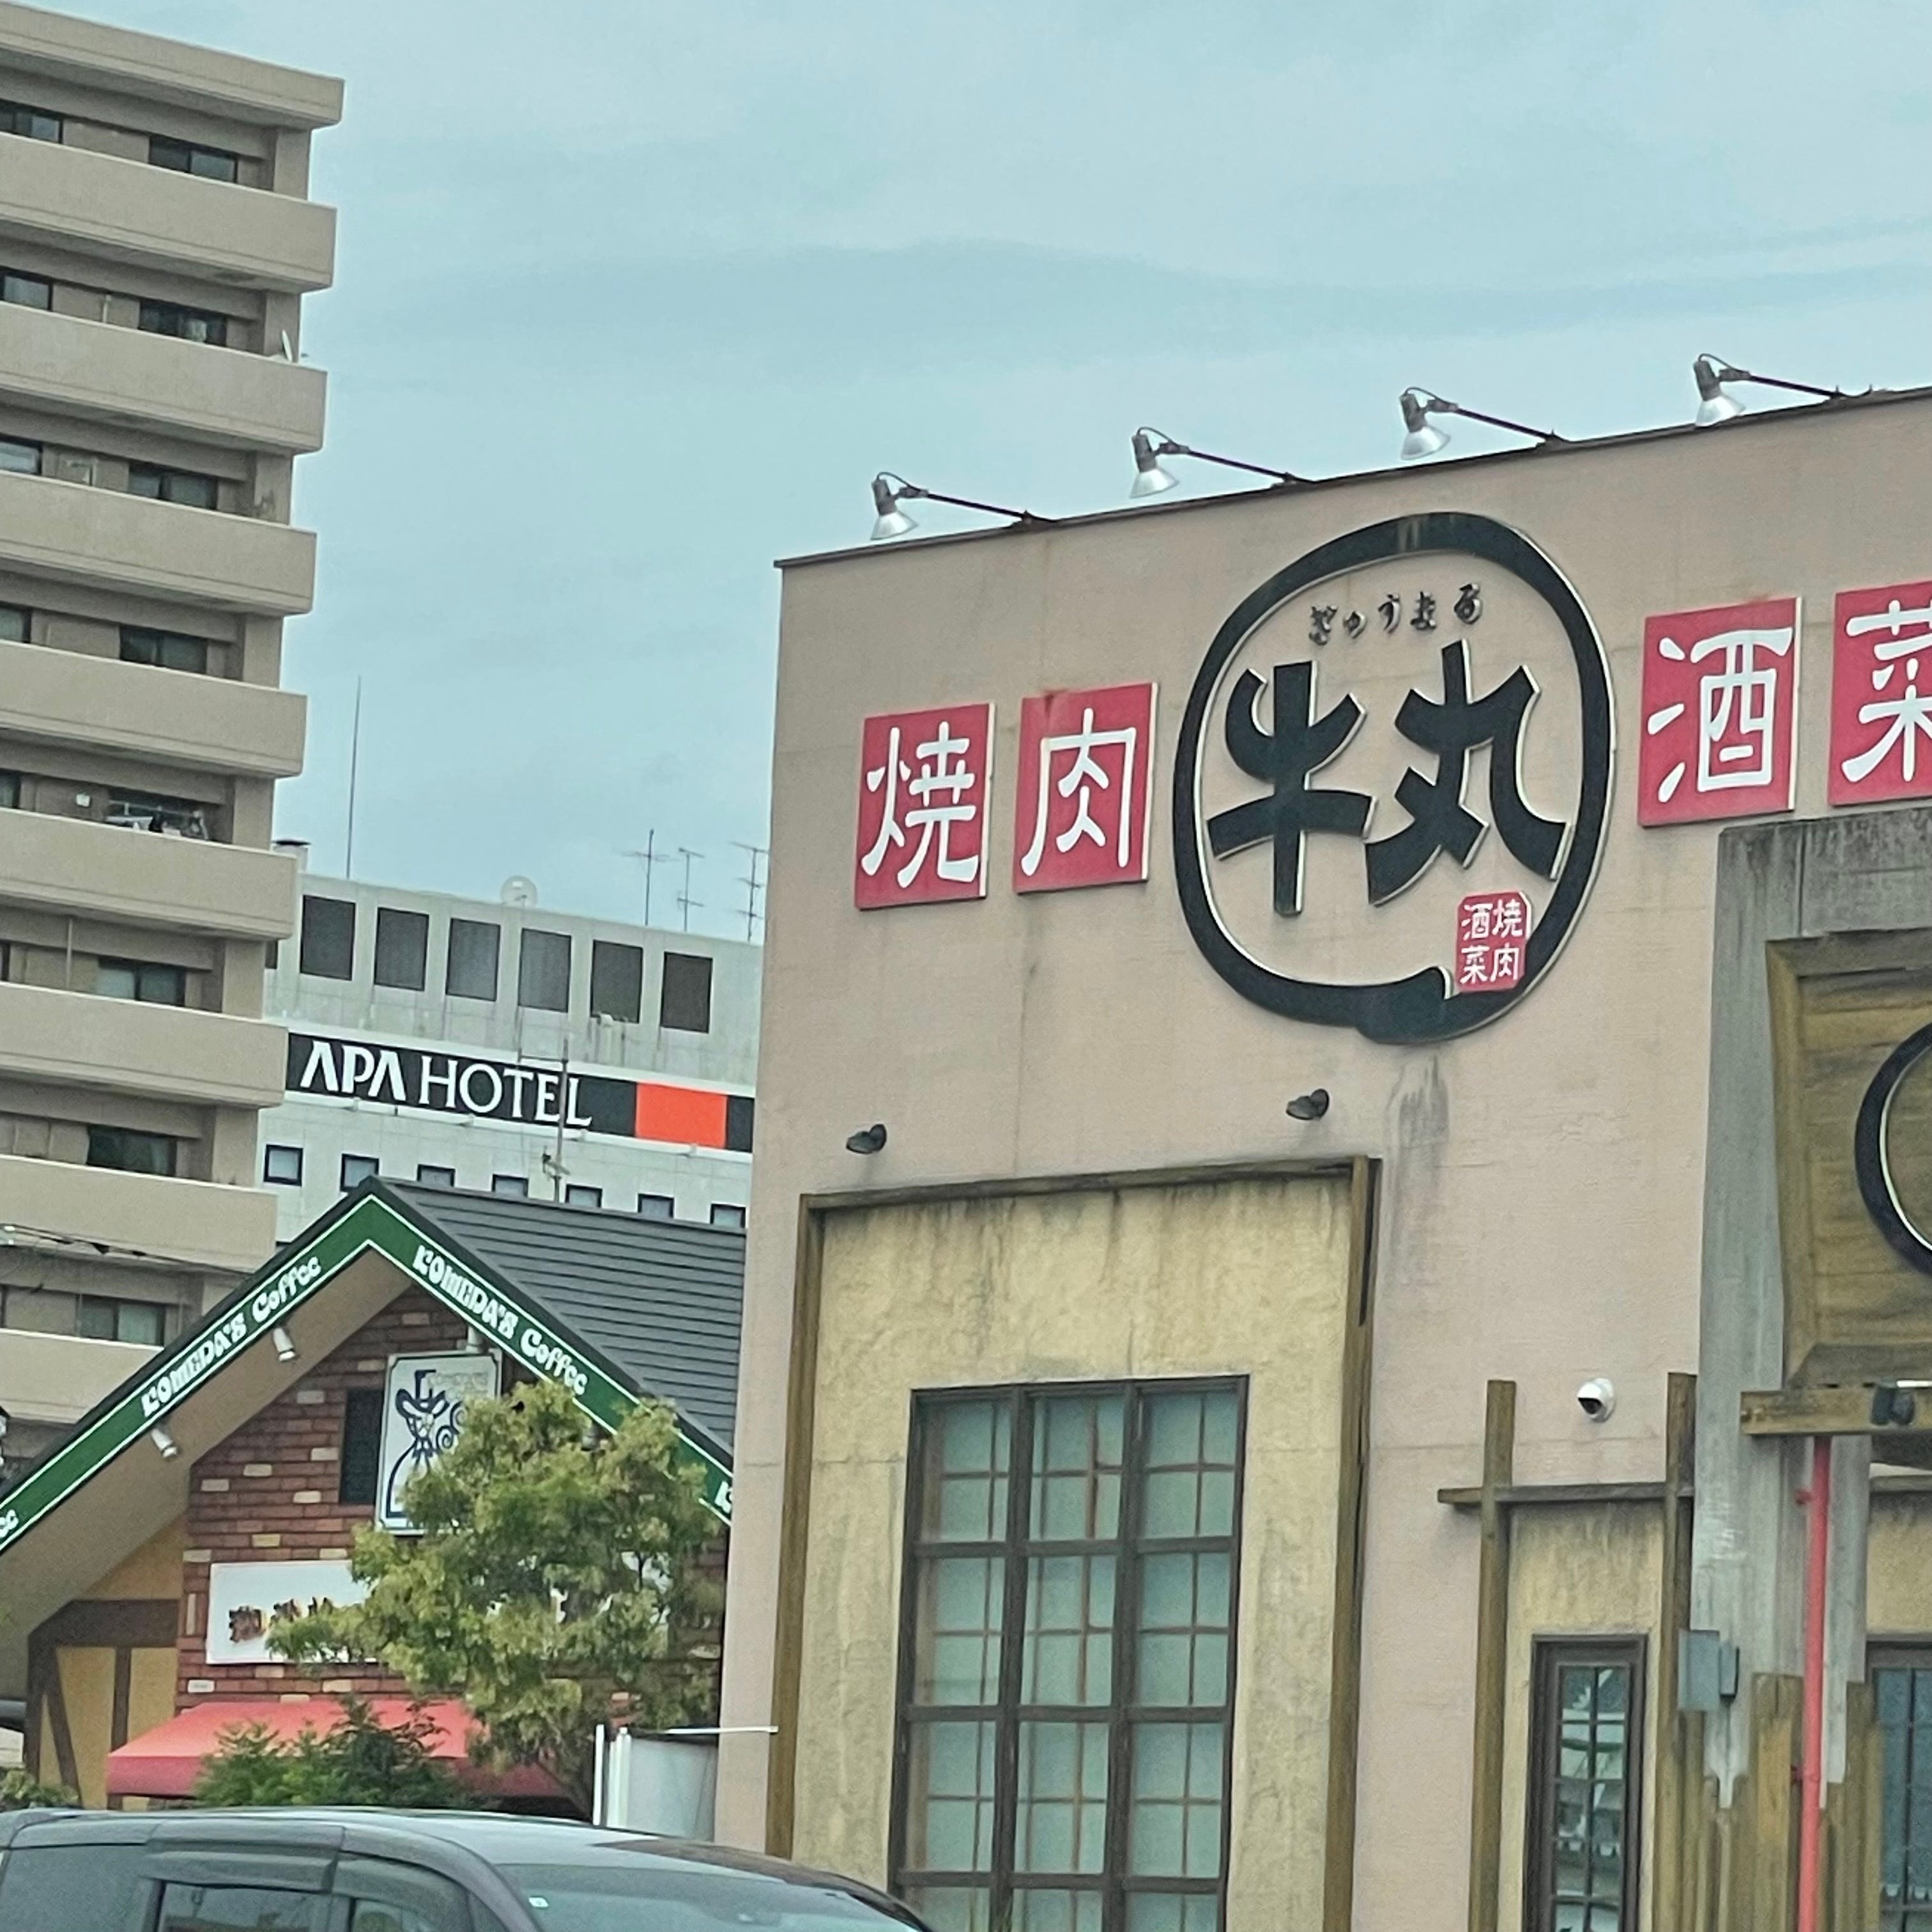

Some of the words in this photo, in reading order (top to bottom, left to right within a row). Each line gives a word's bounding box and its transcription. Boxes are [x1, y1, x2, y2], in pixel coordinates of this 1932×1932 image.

[1309, 583, 1482, 645] ぎゅうまる
[861, 708, 1137, 888] 焼肉
[1206, 640, 1572, 917] 牛丸
[1460, 903, 1493, 984] 酒菜
[1489, 899, 1523, 982] 焼肉
[300, 1041, 406, 1101] APA
[419, 1057, 593, 1128] HOTEL
[141, 1312, 247, 1418] KOMEDA'S
[252, 1256, 321, 1322] Coffee
[412, 1245, 519, 1340] KOMEDA'S
[520, 1328, 588, 1395] Coffee
